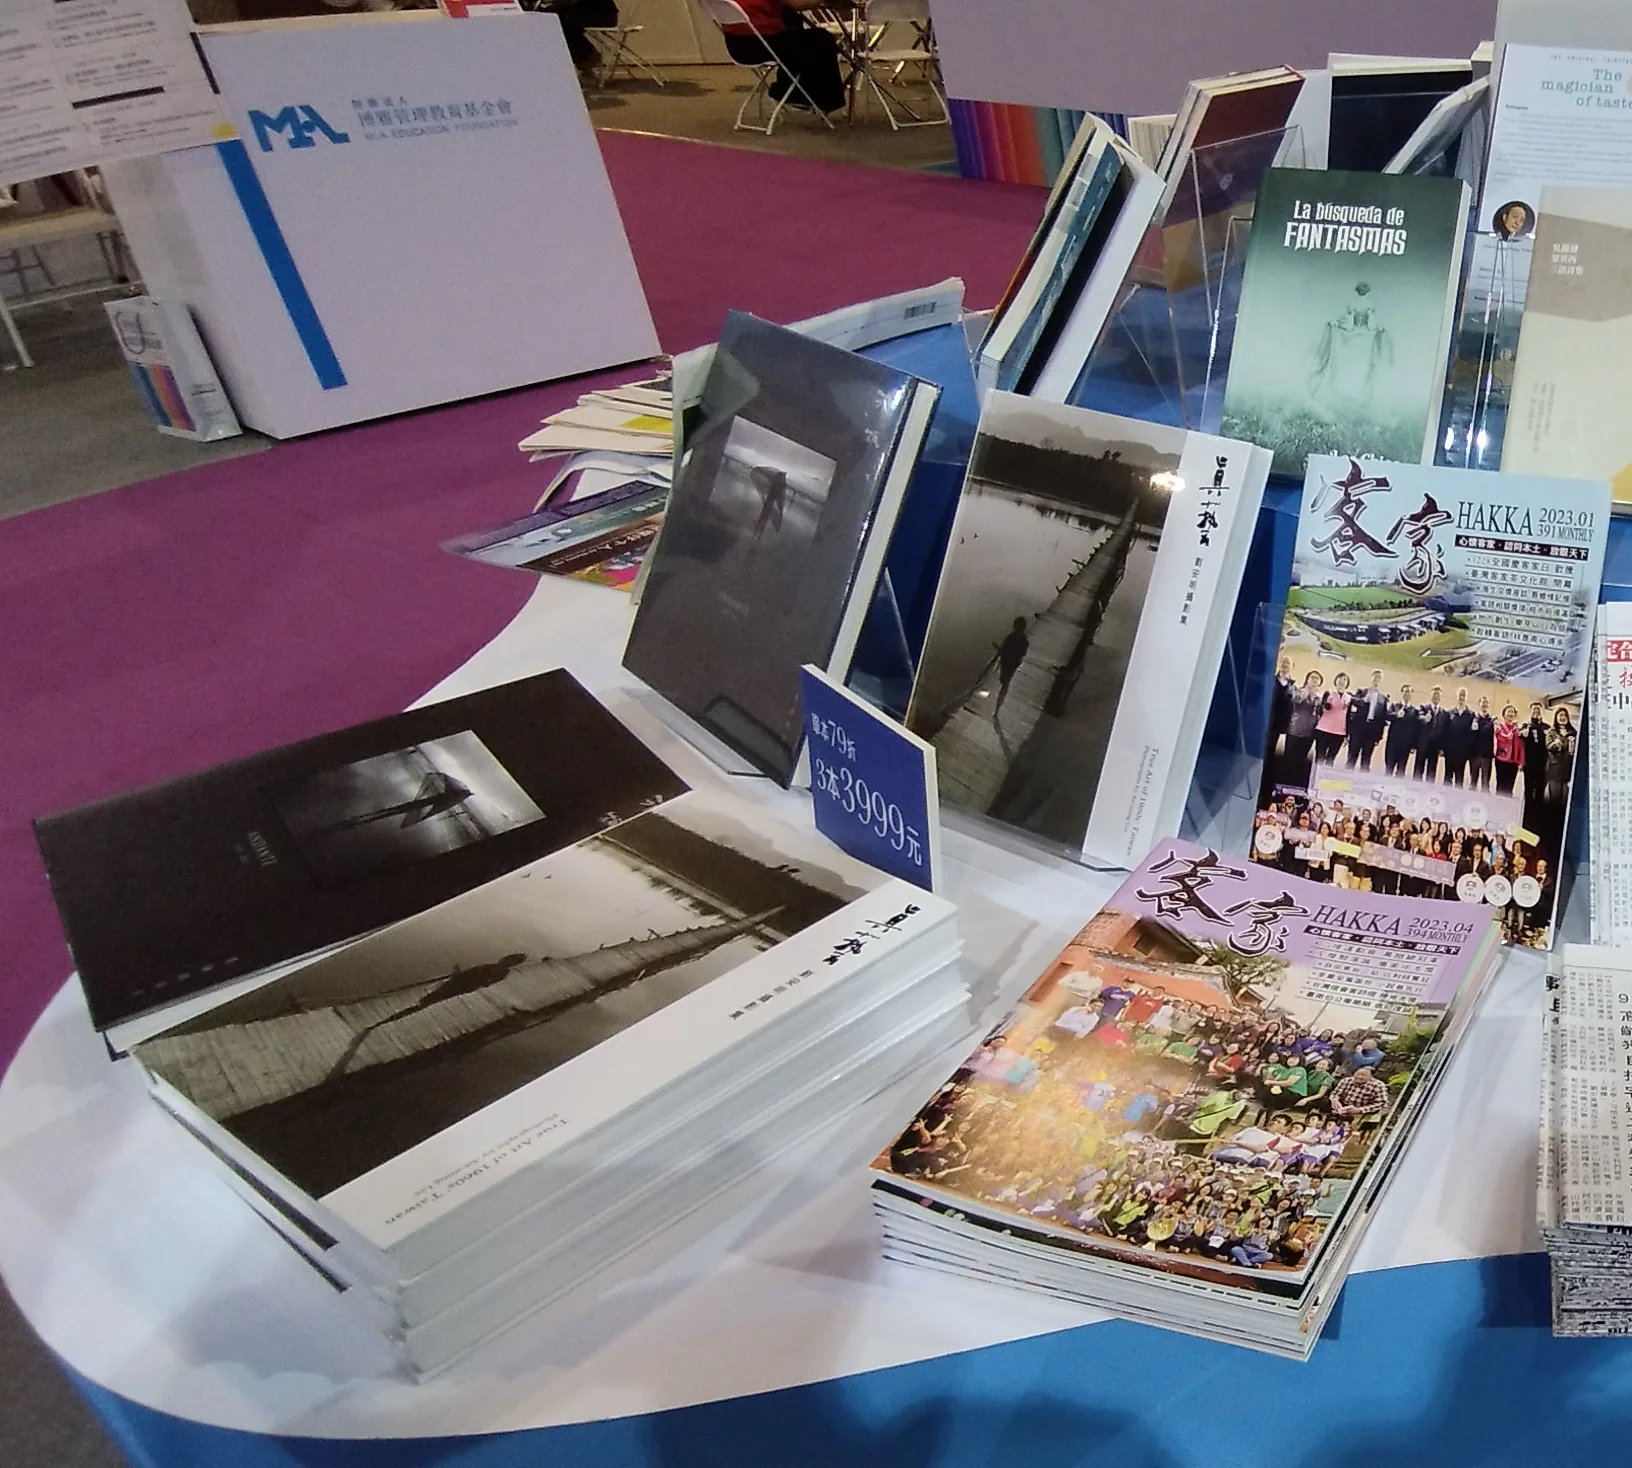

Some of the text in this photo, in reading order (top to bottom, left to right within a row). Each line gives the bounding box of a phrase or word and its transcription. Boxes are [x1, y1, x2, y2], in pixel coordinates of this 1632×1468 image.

[1593, 68, 1623, 82] The
[1540, 79, 1614, 95] magician
[1576, 95, 1592, 107] of
[392, 126, 449, 138] EDUCATION
[455, 119, 519, 132] FOUNDATION
[1294, 200, 1405, 226] La búsqueda de
[1284, 222, 1407, 256] FANTASMAS
[1310, 456, 1455, 595] 客家
[1456, 501, 1534, 536] HAKKA
[1538, 508, 1595, 528] 2023.01
[1536, 525, 1595, 542] 391 MONTHLY
[811, 712, 856, 762] 單本79折
[1149, 747, 1160, 768] True
[1145, 770, 1153, 784] Art
[816, 758, 922, 866] 3本3999元
[1126, 826, 1140, 857] Taiwan
[1135, 848, 1310, 957] 客家
[1311, 904, 1401, 936] HAKKA
[1409, 917, 1474, 935] 2023.04
[1404, 927, 1468, 944] 394 MONTHLY
[536, 1119, 570, 1138] True
[510, 1138, 533, 1153] Art
[494, 1153, 508, 1164] of
[385, 1192, 444, 1226] Taiwan
